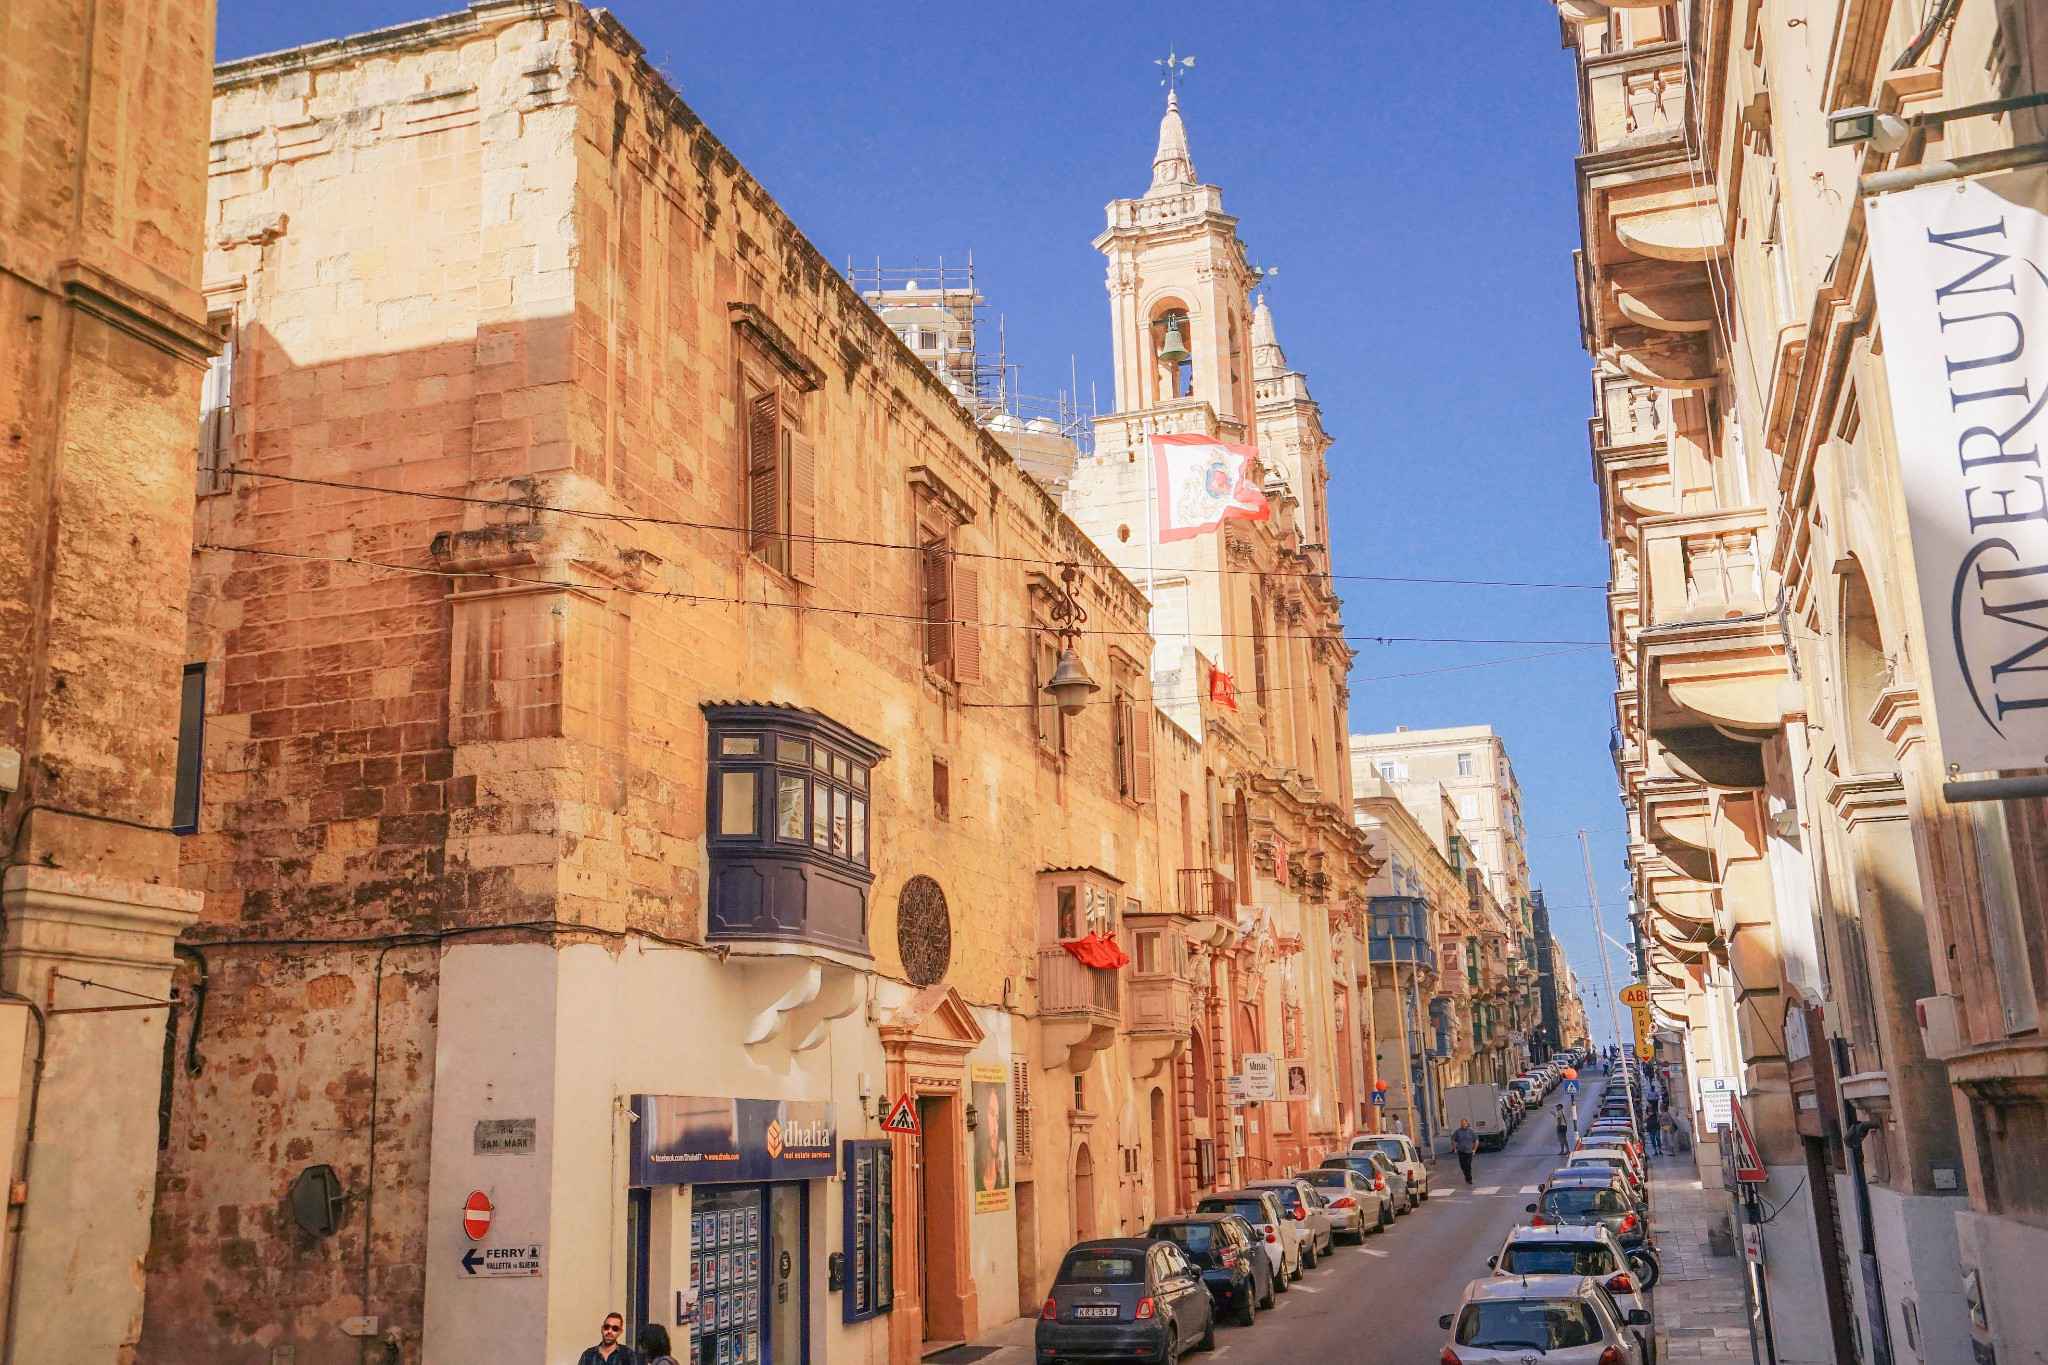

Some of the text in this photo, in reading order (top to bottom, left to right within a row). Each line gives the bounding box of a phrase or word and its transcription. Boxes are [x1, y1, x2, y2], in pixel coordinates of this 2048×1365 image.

[1926, 214, 2048, 738] IMPERIUM
[783, 1119, 831, 1147] dhalia
[480, 1137, 528, 1149] SAN MARK
[486, 1248, 525, 1258] FERRY
[486, 1262, 512, 1270] VALLETTA
